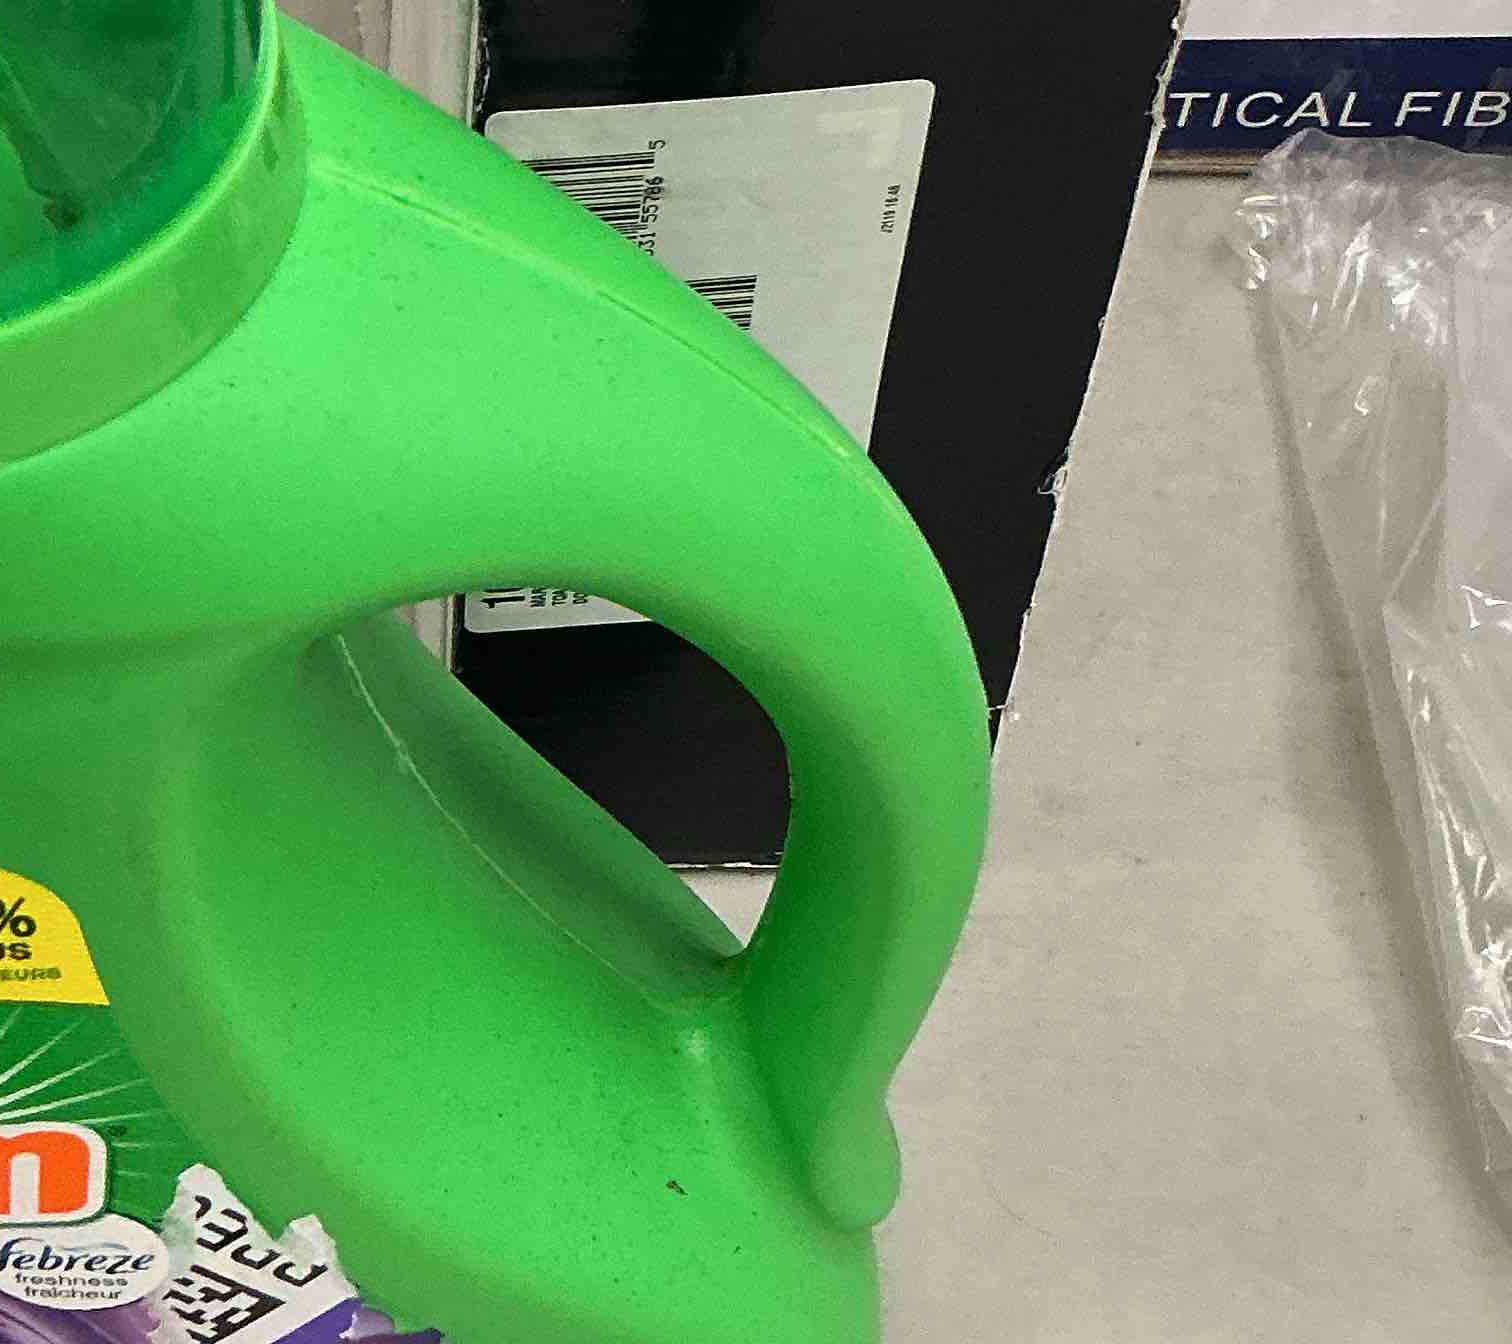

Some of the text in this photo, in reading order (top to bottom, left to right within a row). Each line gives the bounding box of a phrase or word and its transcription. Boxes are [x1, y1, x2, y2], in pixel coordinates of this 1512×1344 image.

[1169, 90, 1512, 129] TICAL FIB
[649, 139, 667, 151] 5
[14, 1273, 129, 1287] freshness
